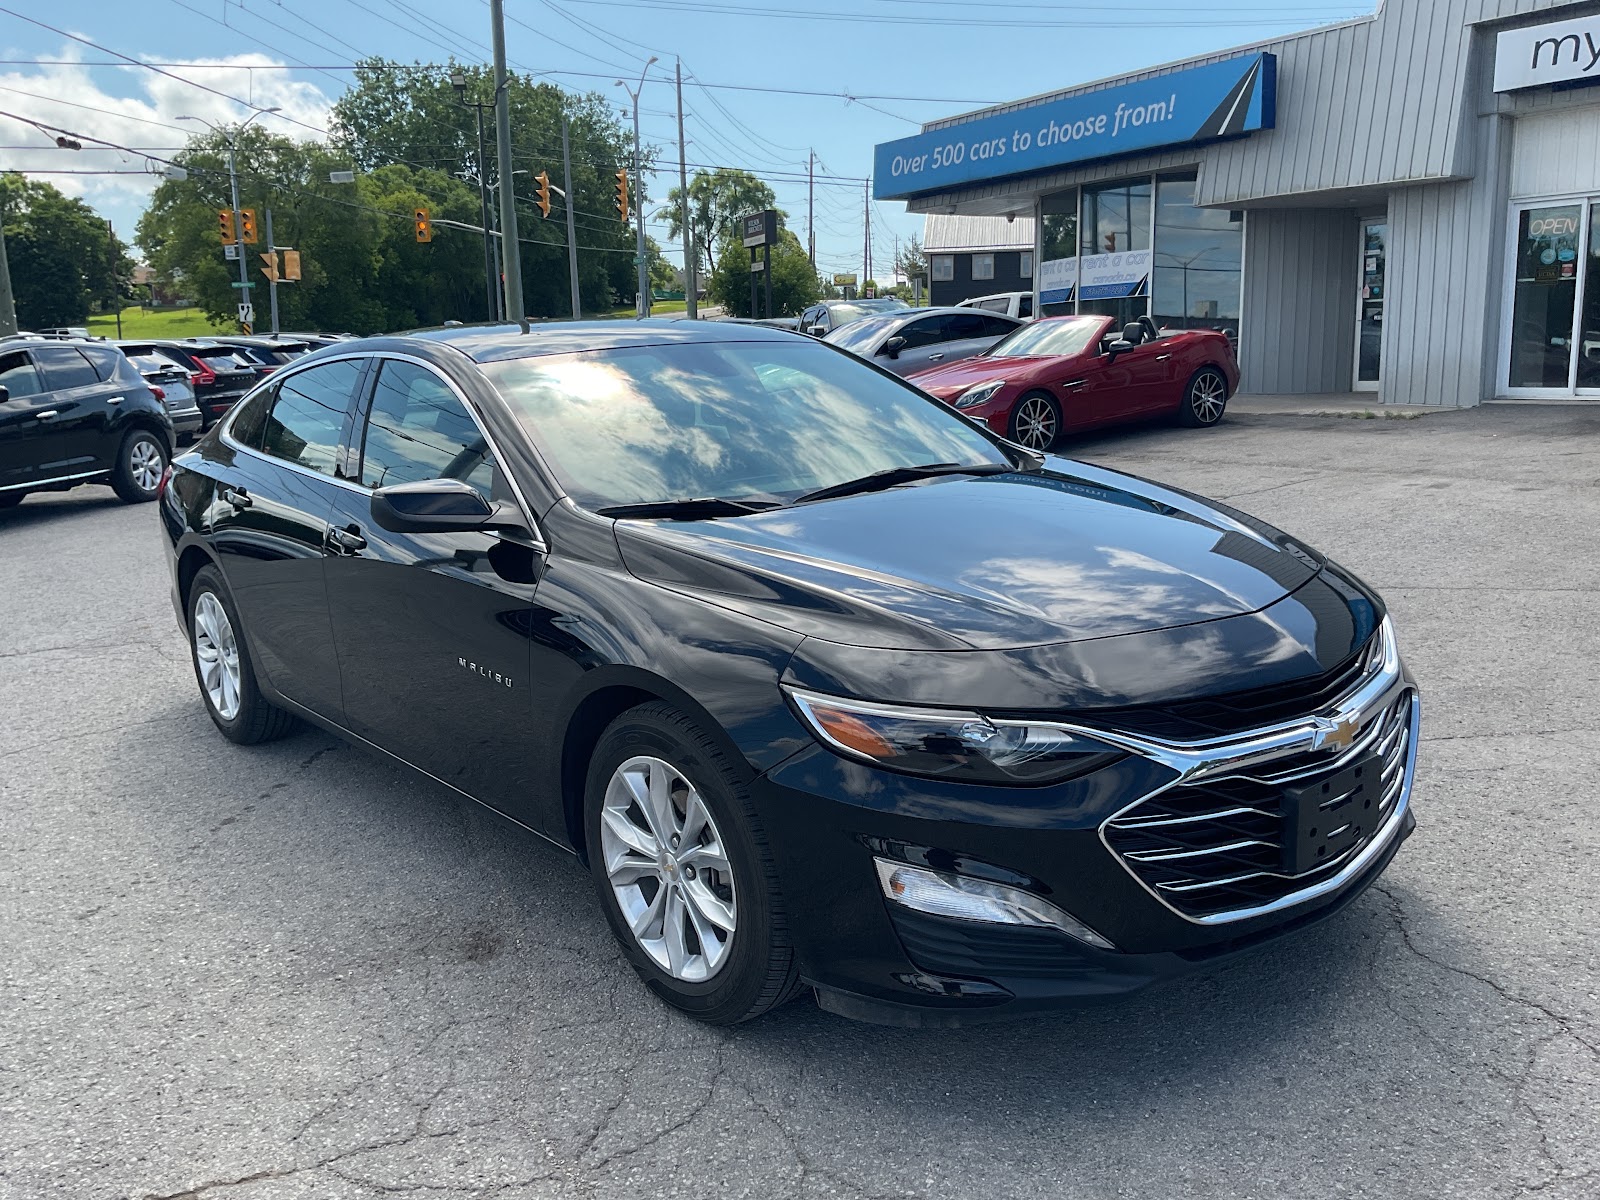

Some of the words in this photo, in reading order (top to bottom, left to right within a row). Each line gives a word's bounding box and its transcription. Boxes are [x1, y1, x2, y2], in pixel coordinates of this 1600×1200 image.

[891, 154, 928, 177] Over
[931, 142, 965, 168] 500
[969, 138, 1006, 161] cars
[1012, 129, 1031, 152] to
[1037, 114, 1106, 148] choose
[1112, 94, 1176, 137] from!
[1530, 218, 1578, 235] OPEN
[1081, 253, 1109, 270] rent
[1112, 255, 1122, 267] a
[1126, 252, 1150, 266] car
[458, 657, 512, 688] MALIBU
